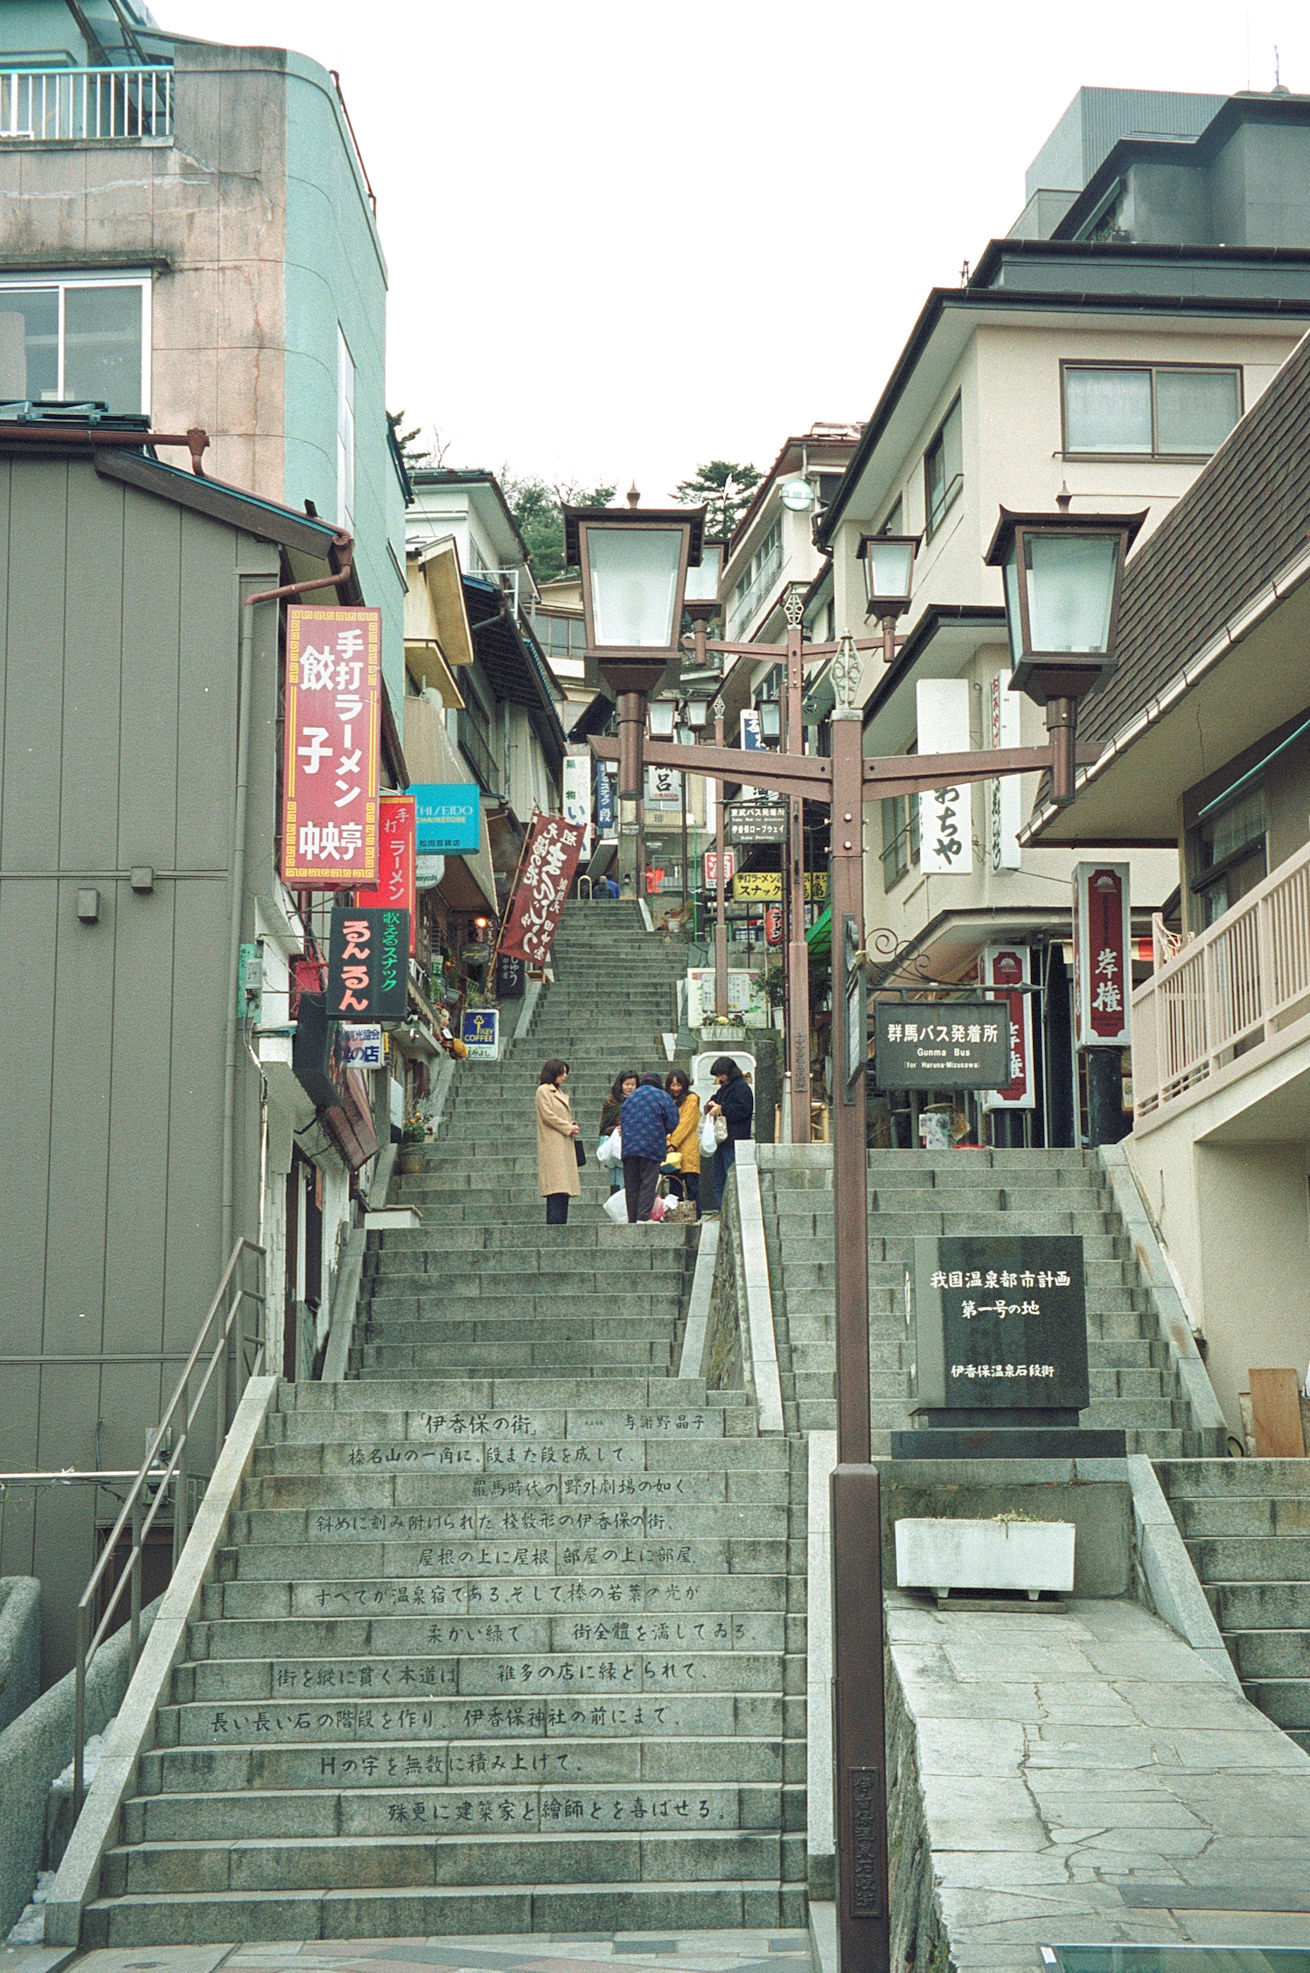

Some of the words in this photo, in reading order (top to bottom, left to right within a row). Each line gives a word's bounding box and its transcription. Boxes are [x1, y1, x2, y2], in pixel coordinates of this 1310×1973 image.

[298, 646, 335, 775] 餃子
[334, 629, 364, 808] 手打ラーメン
[384, 807, 409, 901] 手打ラーメン
[740, 886, 781, 896] スナック
[771, 913, 782, 940] ラーメン
[381, 912, 400, 992] 歌えるスナック
[339, 920, 371, 1012] るんるん
[1092, 948, 1122, 1012] 岸権
[464, 1034, 493, 1042] COFFEE
[888, 1024, 998, 1043] 群馬バス発着所
[917, 1048, 946, 1057] Gunma
[954, 1048, 970, 1057] Bus
[930, 1270, 1071, 1289] 我国温泉都市計画
[961, 1300, 1040, 1319] 第一号の地
[951, 1364, 1055, 1378] 伊香保温泉石段街
[421, 1414, 538, 1436] 「伊香保の街」
[625, 1414, 705, 1432] 与謝野晶子
